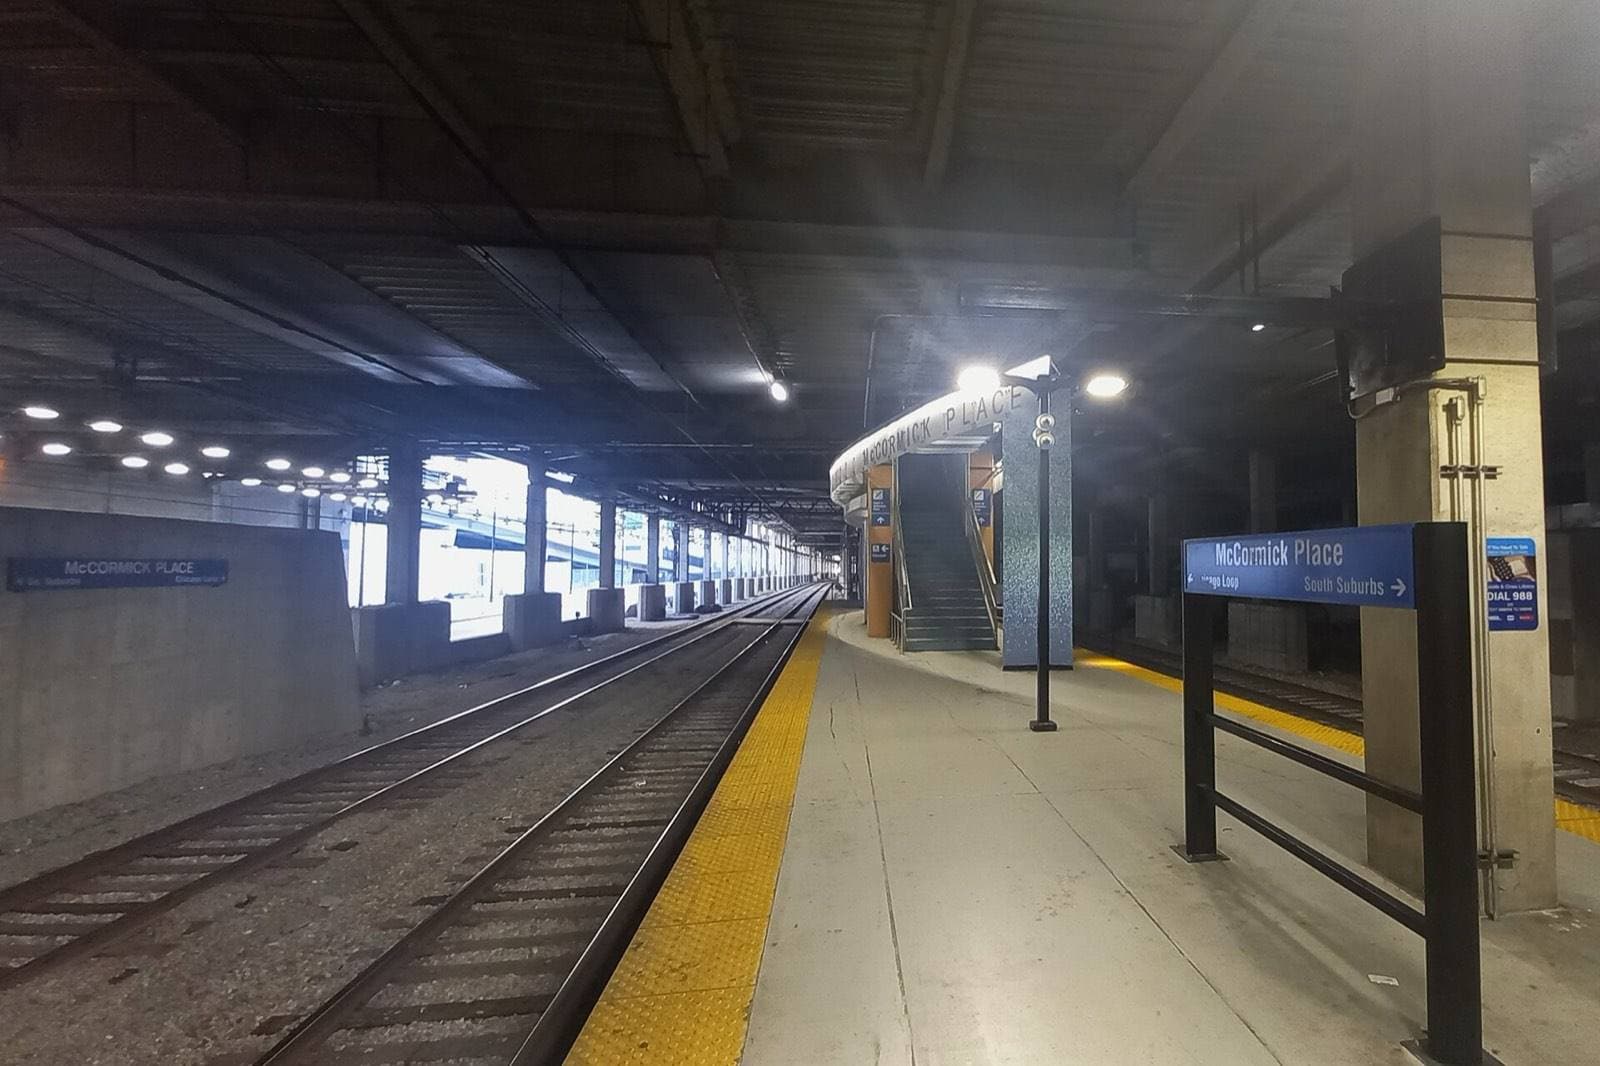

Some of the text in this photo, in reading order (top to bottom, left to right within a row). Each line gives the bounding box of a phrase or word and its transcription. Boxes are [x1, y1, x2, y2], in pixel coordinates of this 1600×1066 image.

[946, 387, 1022, 431] PLACE
[1215, 538, 1343, 567] McCormick Place
[64, 561, 193, 575] McCORMICK PLACE
[1222, 573, 1239, 590] Loop
[1304, 575, 1385, 596] South Suburbs
[1487, 591, 1533, 601] DIAL 988
